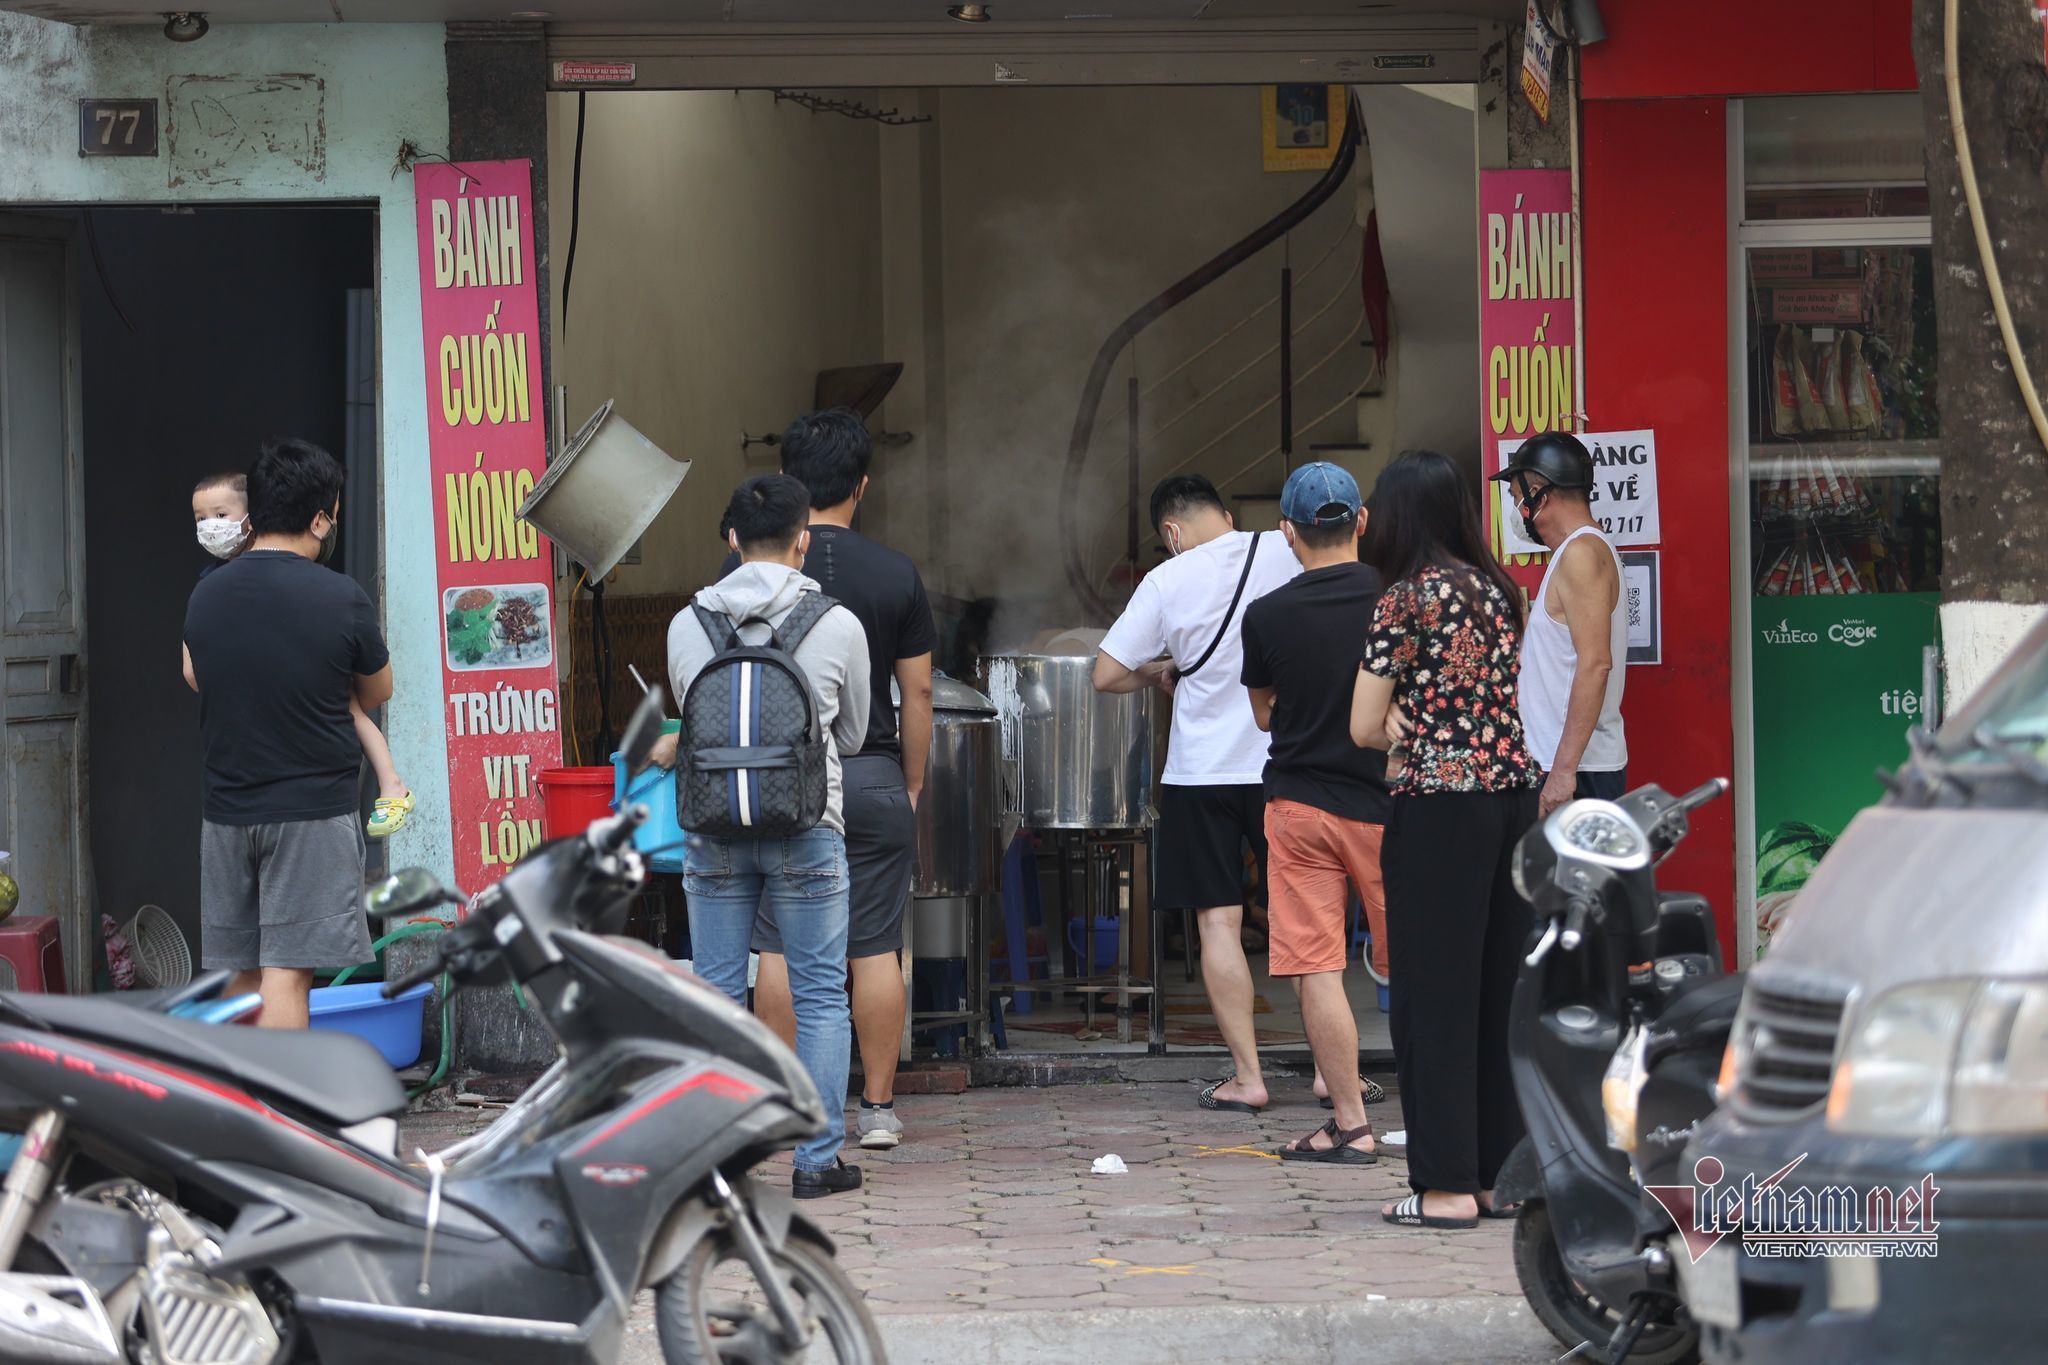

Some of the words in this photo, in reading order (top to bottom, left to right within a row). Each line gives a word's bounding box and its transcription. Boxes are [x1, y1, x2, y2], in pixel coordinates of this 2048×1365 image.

[95, 109, 142, 146] 77
[432, 178, 522, 289] BÁNH
[1488, 193, 1573, 301] BÁNH
[439, 300, 530, 427] CUỐN
[1488, 313, 1574, 435] CUỐN
[1592, 442, 1648, 467] ÀNG
[445, 451, 539, 563] NÓNG
[1608, 473, 1640, 502] VỀ
[1762, 629, 1818, 644] VinEco
[450, 681, 557, 737] TRỨNG
[1879, 688, 1924, 720] tiệ
[483, 754, 531, 809] VỊT
[480, 810, 542, 873] LỘN
